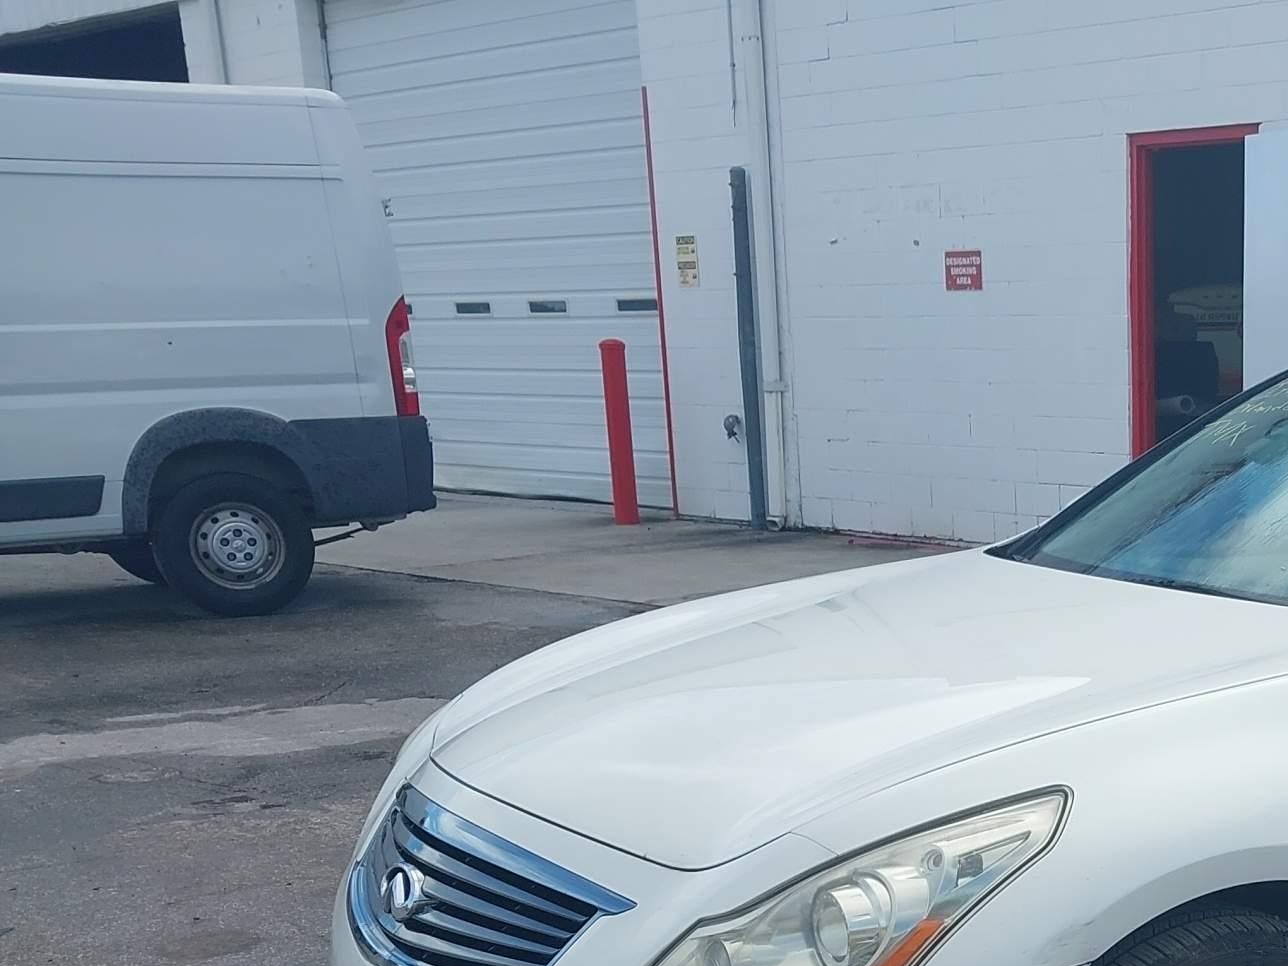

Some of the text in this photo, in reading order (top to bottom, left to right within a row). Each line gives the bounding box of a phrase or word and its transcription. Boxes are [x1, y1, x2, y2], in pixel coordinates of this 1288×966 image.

[946, 256, 981, 266] DESIGNATED
[950, 266, 977, 276] SMOKING
[956, 276, 972, 285] AREA
